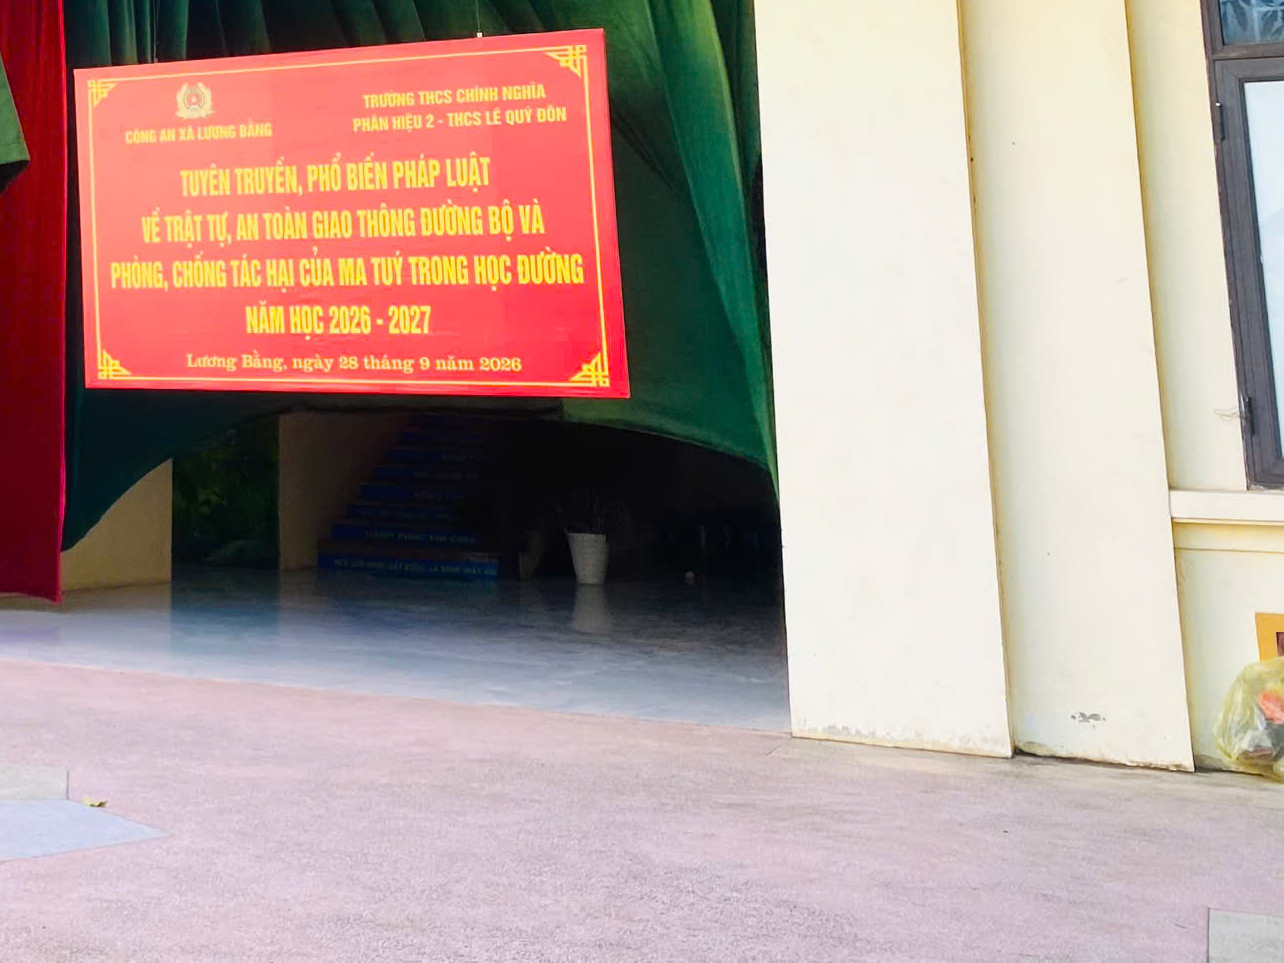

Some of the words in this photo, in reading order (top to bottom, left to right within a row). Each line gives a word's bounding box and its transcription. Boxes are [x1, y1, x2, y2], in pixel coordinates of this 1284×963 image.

[417, 89, 453, 105] THCS
[456, 85, 499, 103] CHÍNH
[159, 127, 176, 142] AN
[392, 112, 422, 133] HIỆU
[426, 115, 435, 129] 2
[447, 111, 482, 128] THCS
[486, 108, 501, 126] LÊ
[179, 163, 231, 197] TUYÊN
[234, 156, 303, 196] TRUYỀN,
[307, 151, 342, 193] PHỔ
[346, 151, 388, 191] BIẾN
[392, 153, 441, 189] PHÁP
[445, 151, 490, 193] LUẬT
[141, 206, 161, 244] VỀ
[164, 209, 203, 249] TRẬT
[206, 211, 232, 248] TỰ,
[236, 213, 259, 241] AN
[262, 205, 308, 240] TOÀN
[311, 209, 353, 240] GIAO
[356, 202, 416, 238] THÔNG
[419, 198, 484, 237] ĐƯỜNG
[488, 198, 514, 242] BỘ
[518, 198, 546, 235] VÀ
[110, 254, 169, 292] PHÒNG,
[172, 250, 227, 288] CHỐNG
[230, 253, 262, 288] TÁC
[266, 258, 295, 294] HẠI
[299, 245, 335, 287] CỦA
[338, 257, 368, 286] MA
[371, 250, 403, 286] TUÝ
[408, 254, 469, 286] TRONG
[473, 254, 512, 292] HỌC
[516, 246, 585, 285] ĐƯỜNG
[245, 300, 285, 334] NĂM
[289, 305, 325, 341] HỌC
[329, 305, 372, 334] 2026
[388, 305, 431, 334] 2027
[186, 353, 237, 372] Lương
[241, 349, 288, 373] Bằng,
[292, 354, 334, 373] ngày
[339, 356, 358, 370] 28
[364, 354, 414, 374] tháng
[419, 356, 431, 371] 9
[435, 356, 474, 371] năm
[479, 357, 522, 372] 2026
